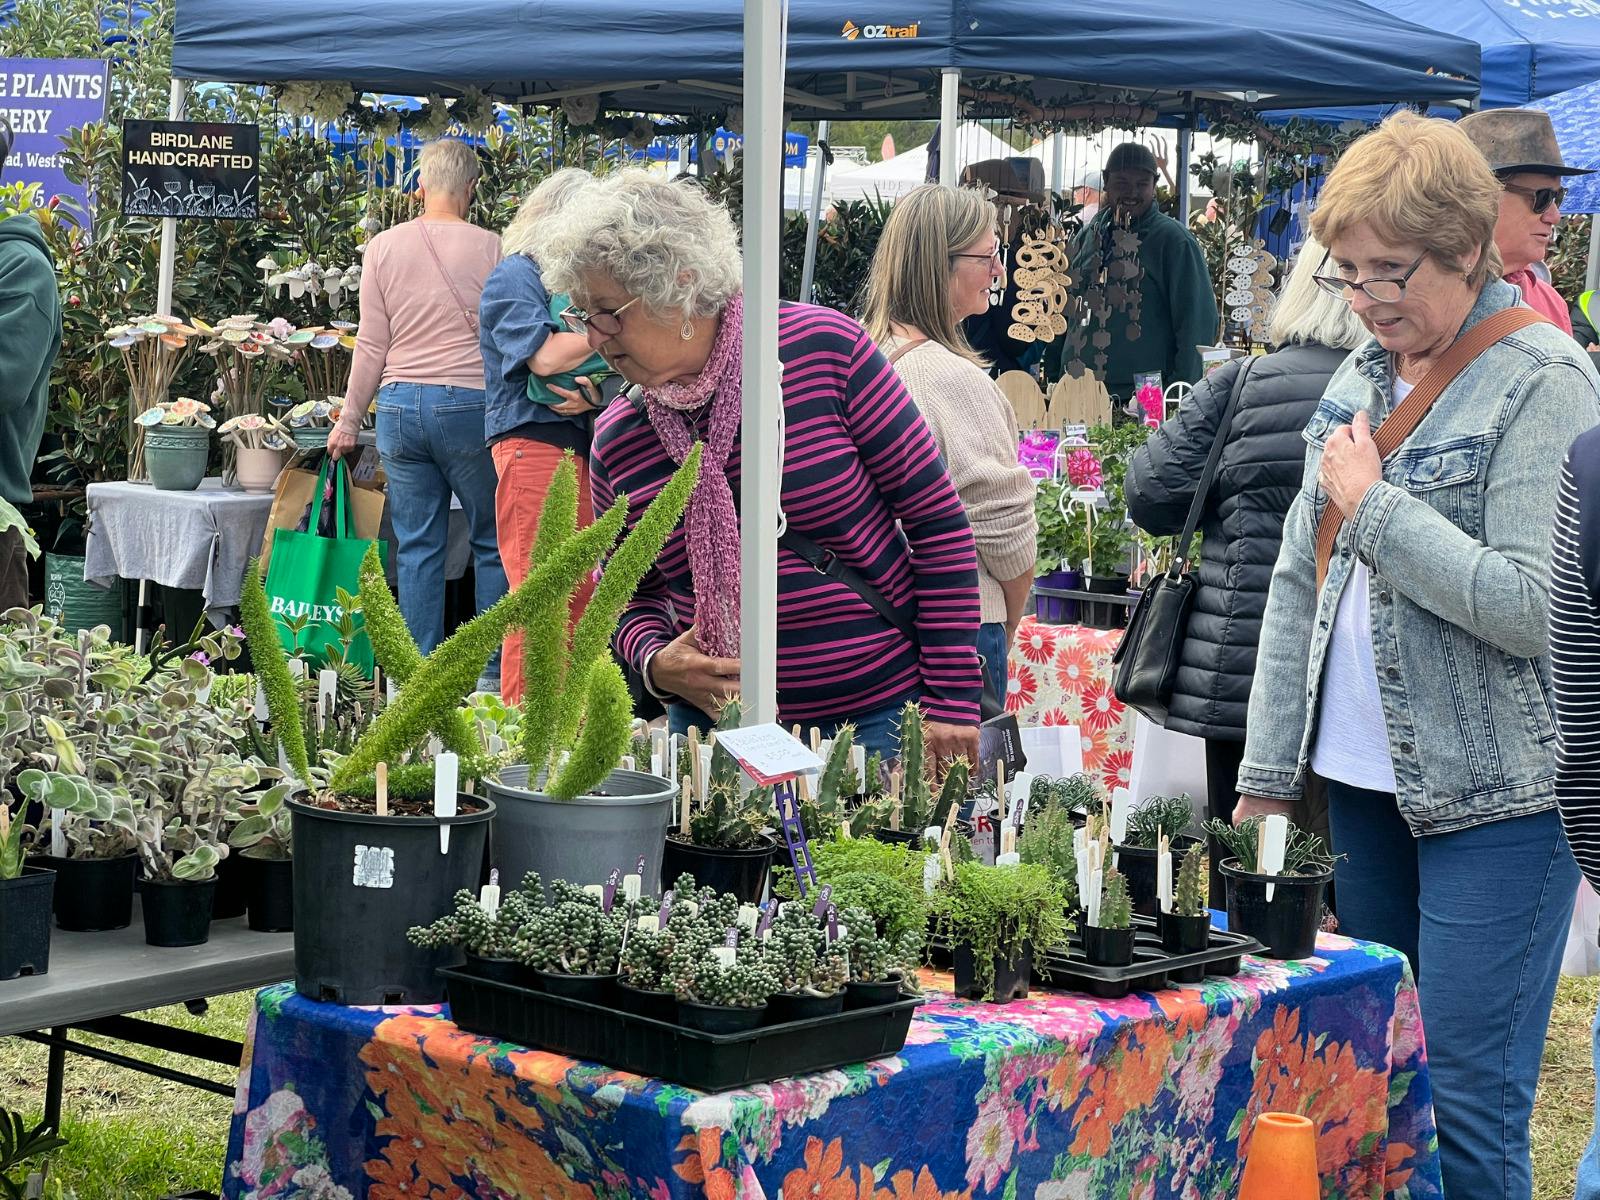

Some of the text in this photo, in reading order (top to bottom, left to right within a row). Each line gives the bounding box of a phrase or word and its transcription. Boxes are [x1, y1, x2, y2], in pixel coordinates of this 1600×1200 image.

[863, 24, 918, 39] OZtrail
[11, 73, 103, 99] PLANTS
[150, 132, 234, 150] BIRDLANE
[26, 152, 56, 168] West
[128, 150, 254, 169] HANDCRAFTED
[270, 596, 345, 623] BAILEYS
